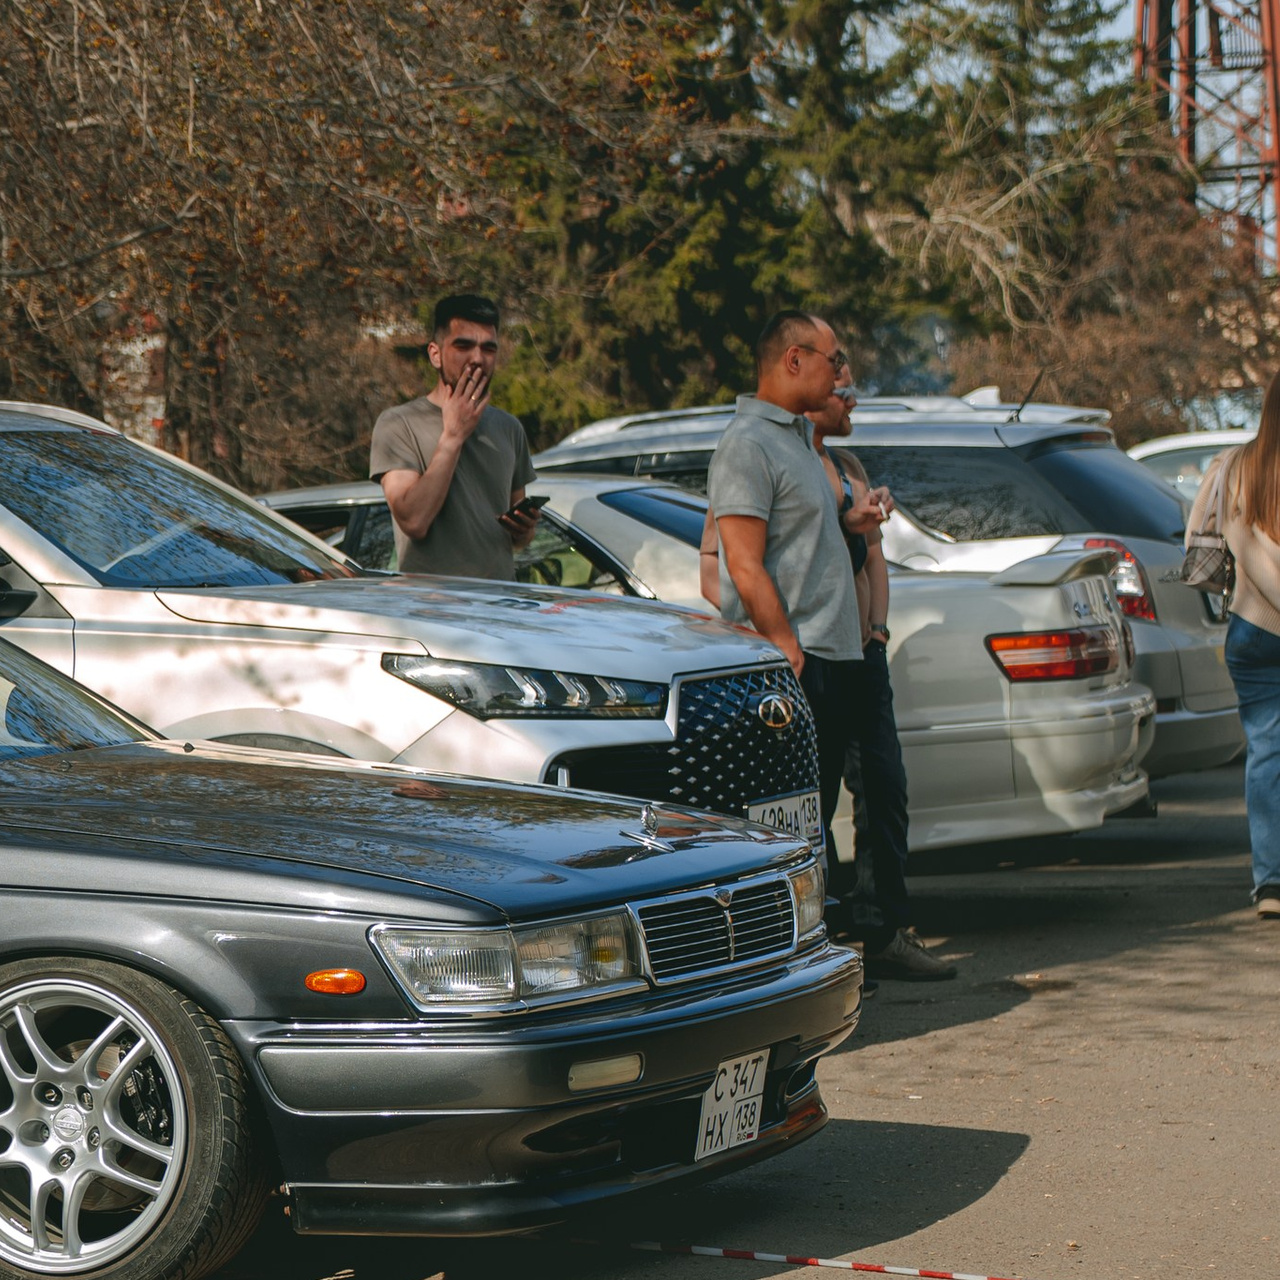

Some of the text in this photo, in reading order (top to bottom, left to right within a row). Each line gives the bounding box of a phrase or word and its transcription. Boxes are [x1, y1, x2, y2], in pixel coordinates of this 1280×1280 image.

[801, 796, 818, 824] 138
[730, 1057, 762, 1098] 347
[736, 1101, 756, 1132] 138
